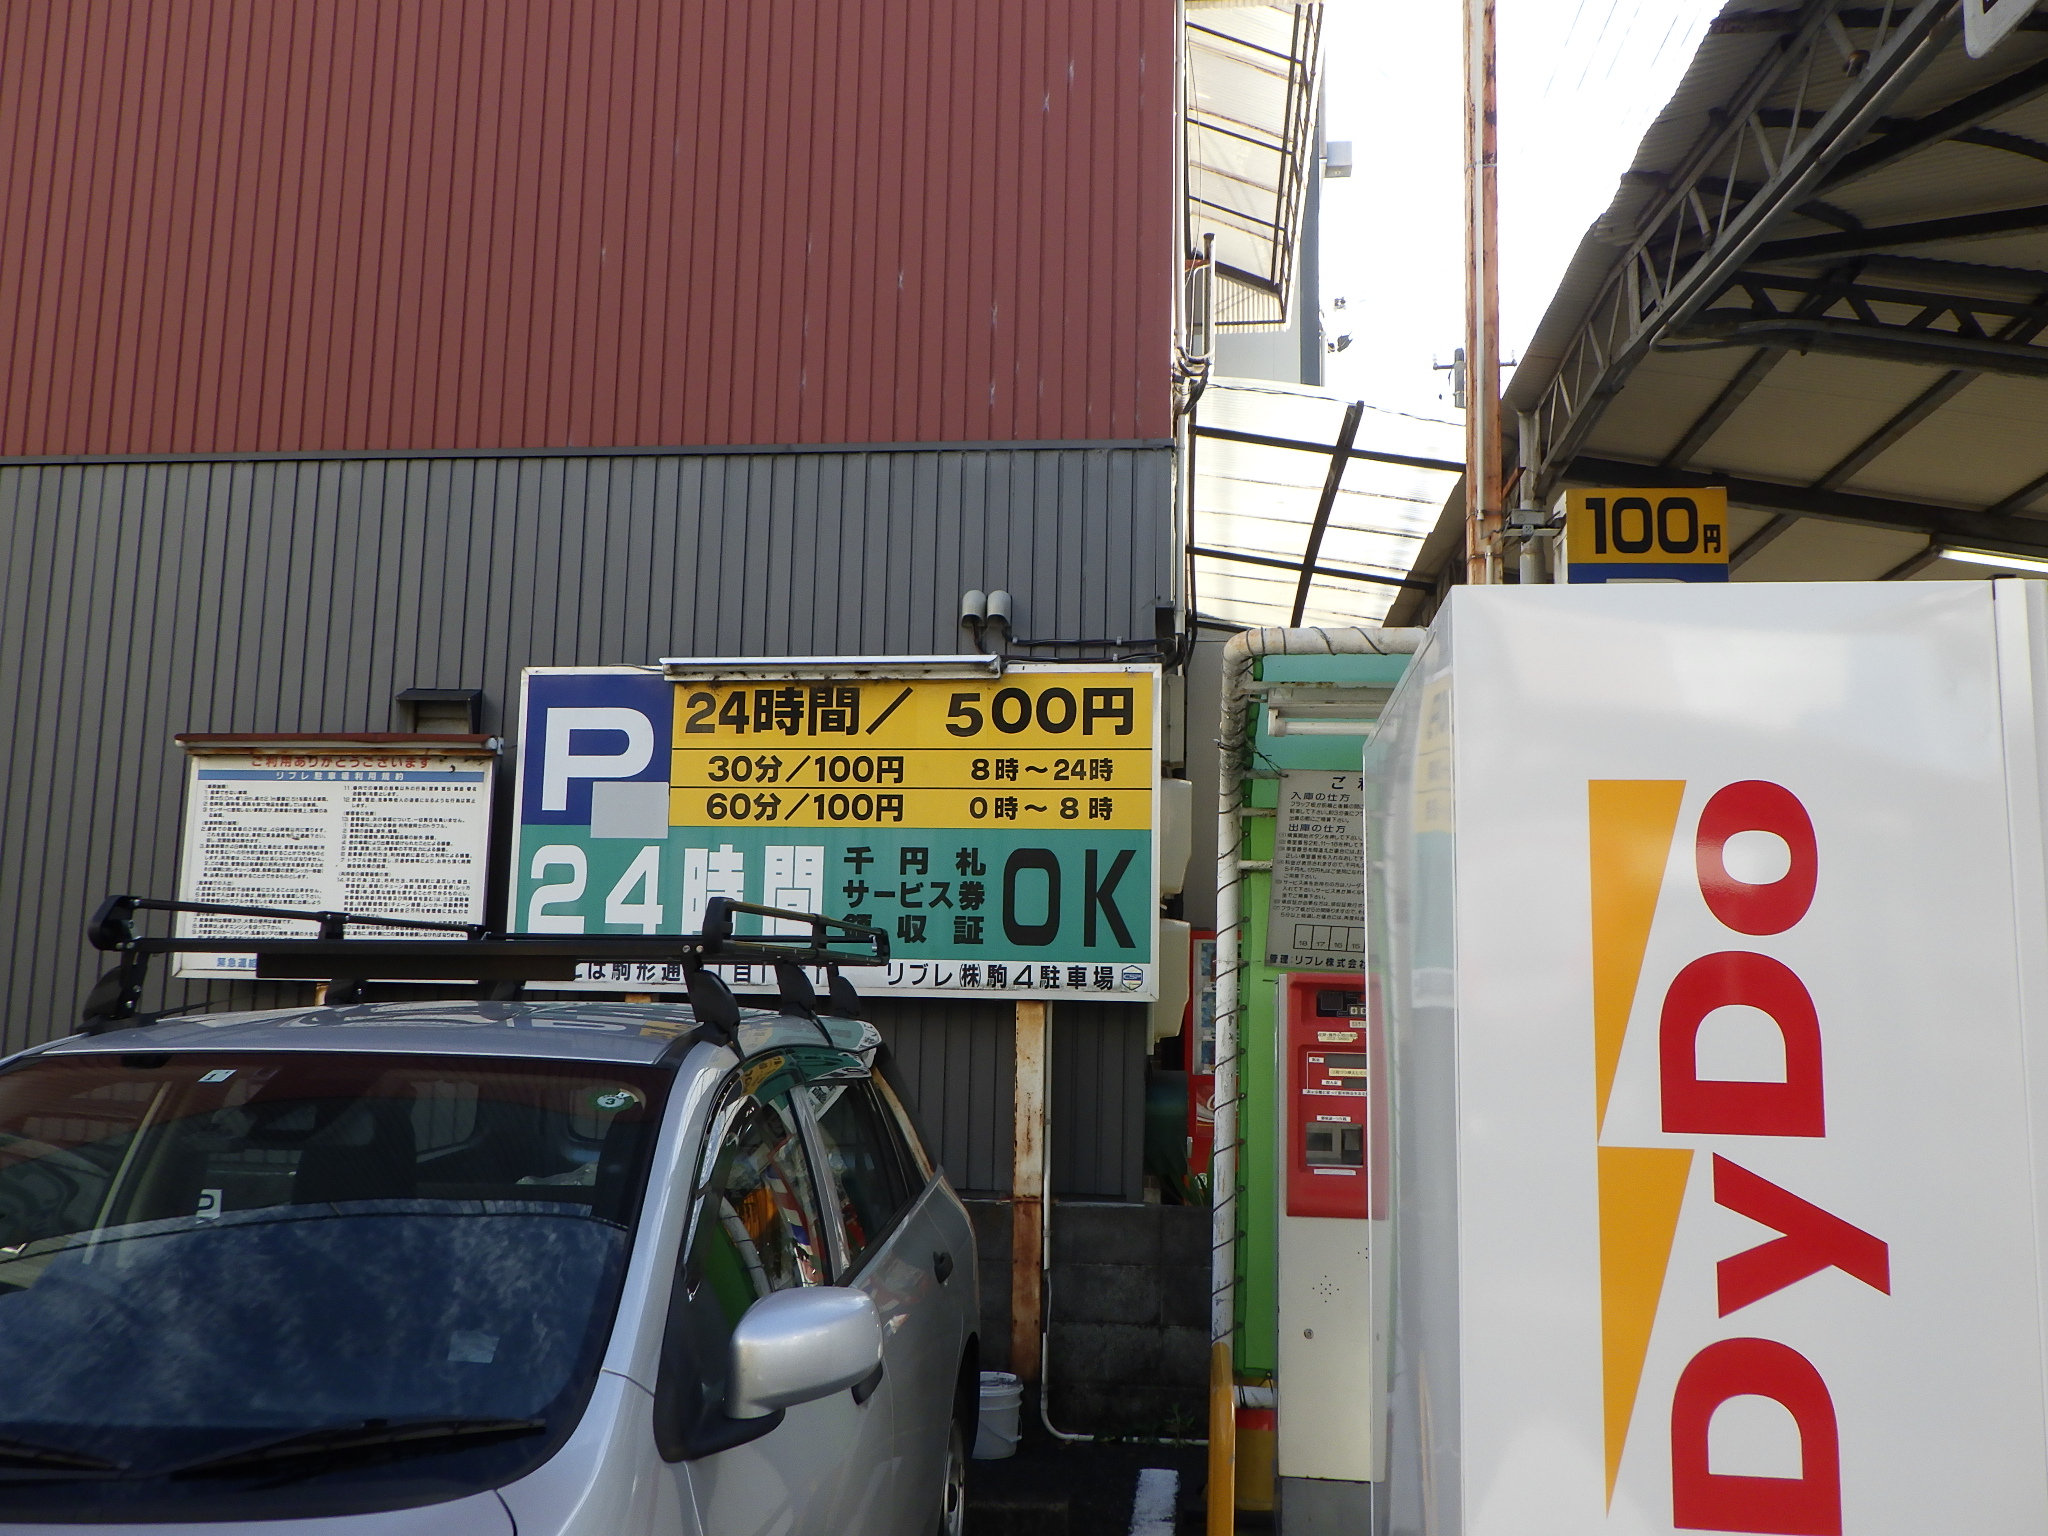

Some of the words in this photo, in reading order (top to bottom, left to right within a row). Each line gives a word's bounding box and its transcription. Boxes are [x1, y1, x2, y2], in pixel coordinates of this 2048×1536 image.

[1586, 497, 1721, 554] 100円
[946, 686, 1134, 738] 500円
[542, 707, 655, 811] P
[707, 755, 904, 784] 30分/100円
[706, 793, 904, 822] 60分/100円
[1290, 791, 1351, 803] 入庫の仕方
[1288, 823, 1346, 834] 出庫の仕方
[843, 846, 987, 876] 千円札
[527, 843, 826, 936] 24時間
[843, 879, 986, 910] サービス券
[1002, 848, 1137, 949] OK
[1659, 779, 1891, 1535] DyDo
